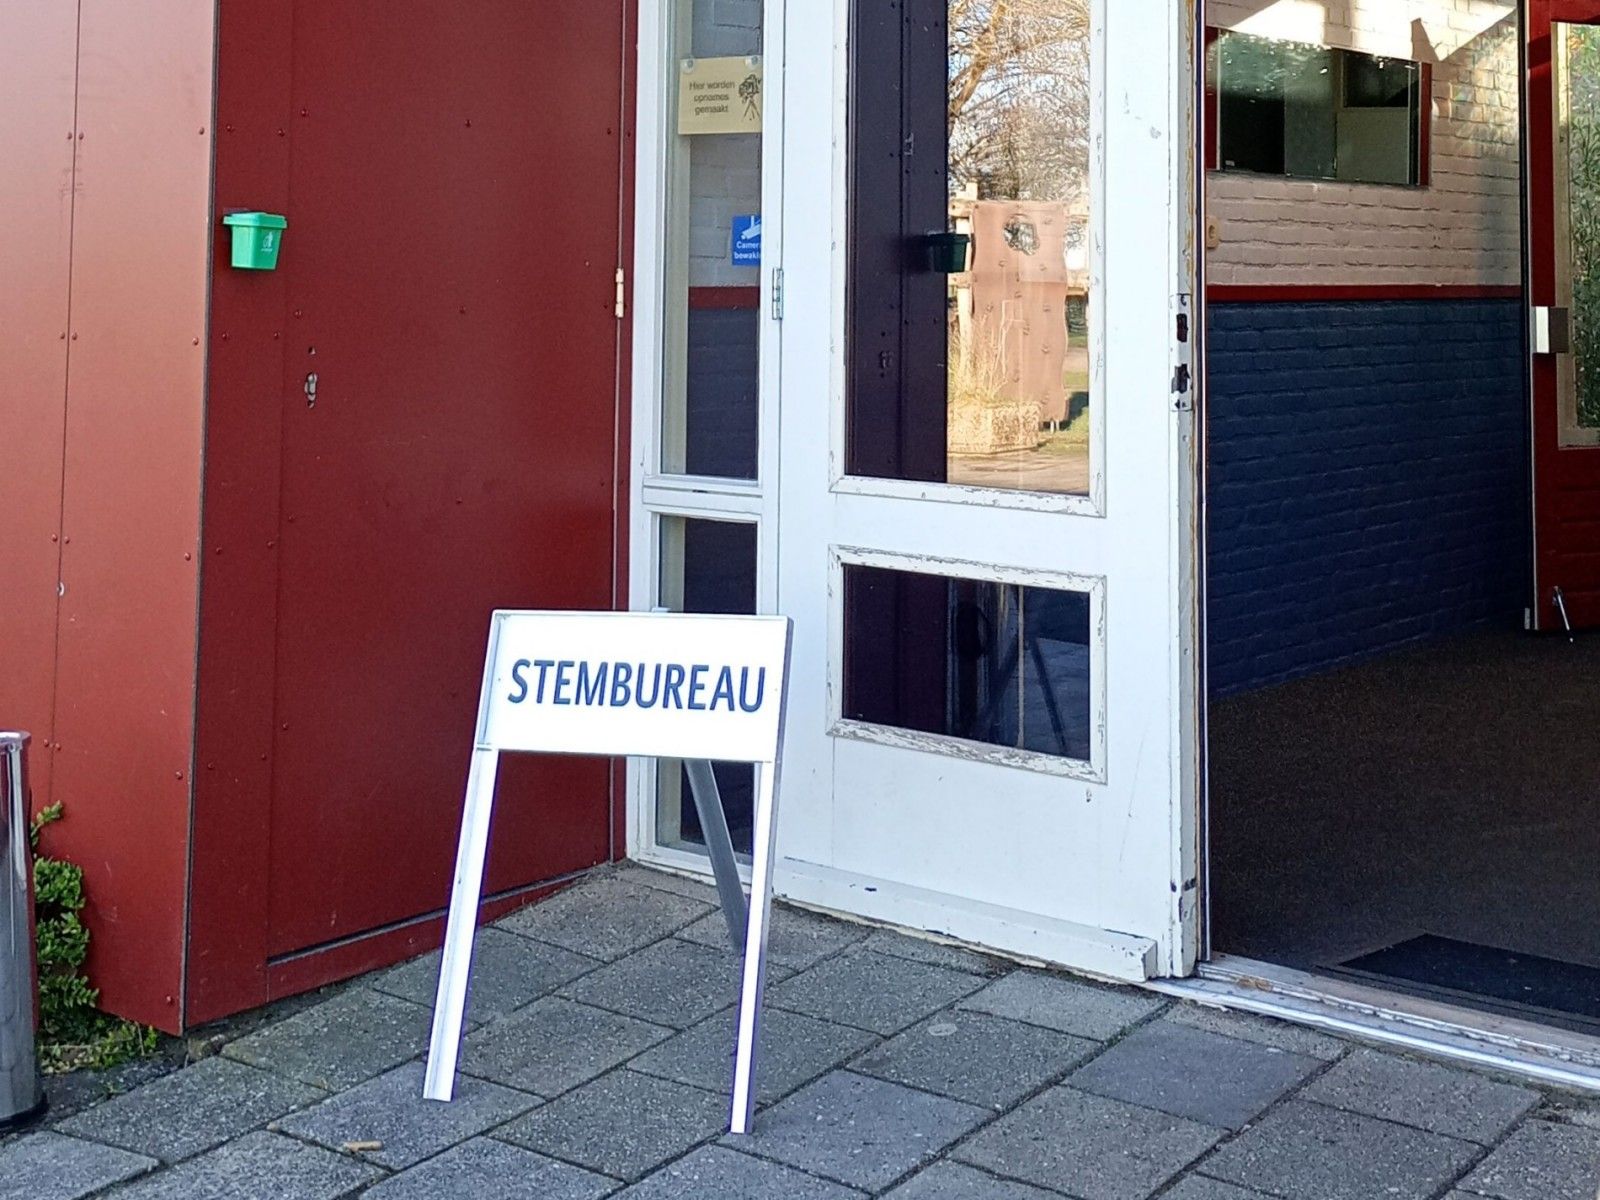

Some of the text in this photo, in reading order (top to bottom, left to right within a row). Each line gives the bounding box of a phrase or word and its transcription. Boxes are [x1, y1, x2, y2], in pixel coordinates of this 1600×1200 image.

[707, 81, 735, 89] worden
[693, 94, 729, 103] opnames
[694, 104, 729, 116] gemaakt
[736, 240, 761, 249] Camer
[507, 658, 766, 713] STEMBUREAU
